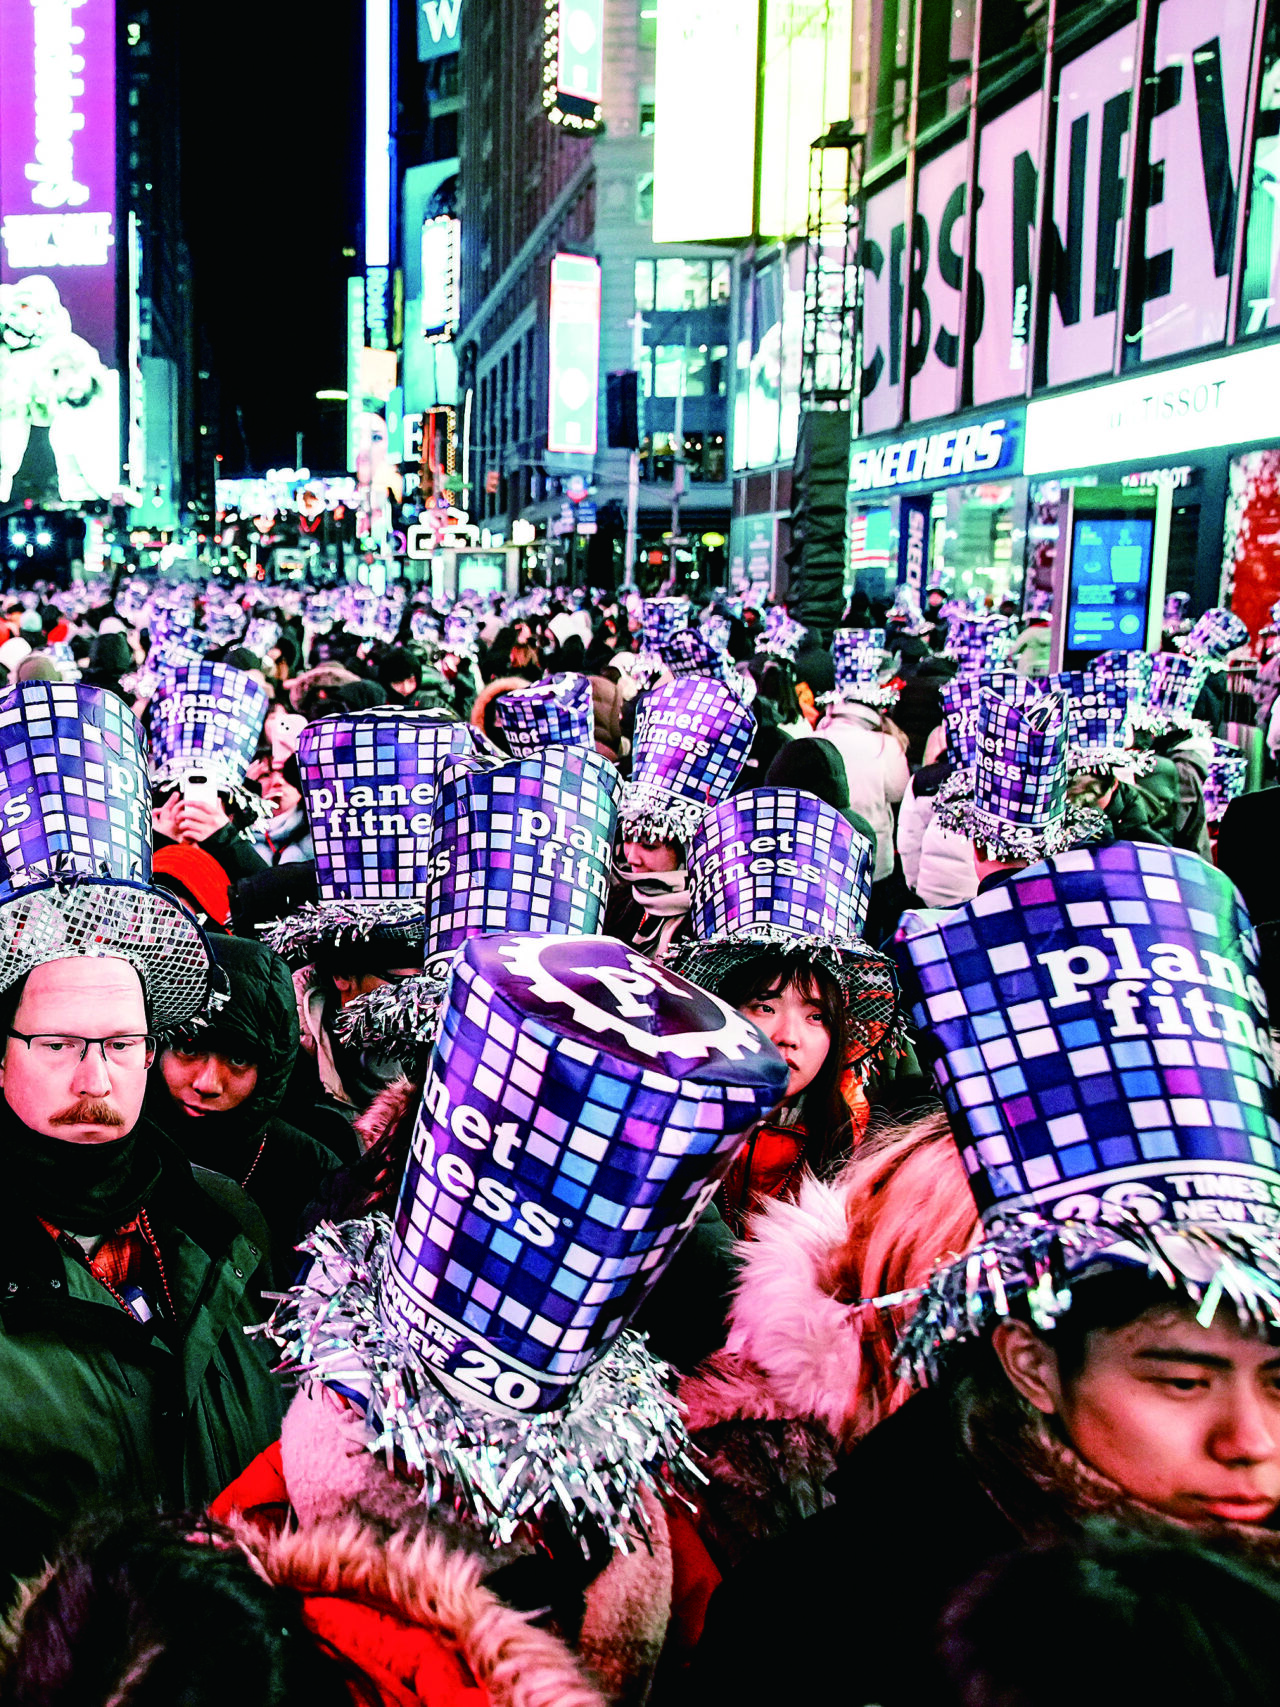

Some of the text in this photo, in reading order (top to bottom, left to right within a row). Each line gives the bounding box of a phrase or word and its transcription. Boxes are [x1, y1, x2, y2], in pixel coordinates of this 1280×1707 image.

[1142, 380, 1226, 420] TISSOT
[849, 419, 1007, 492] SKECHERS
[159, 691, 243, 719] planet
[635, 705, 704, 734] planet
[637, 724, 711, 758] fitness
[689, 831, 795, 906] planet
[694, 857, 822, 916] fitness
[1165, 1173, 1271, 1205] TIMES
[453, 1349, 541, 1410] 20
